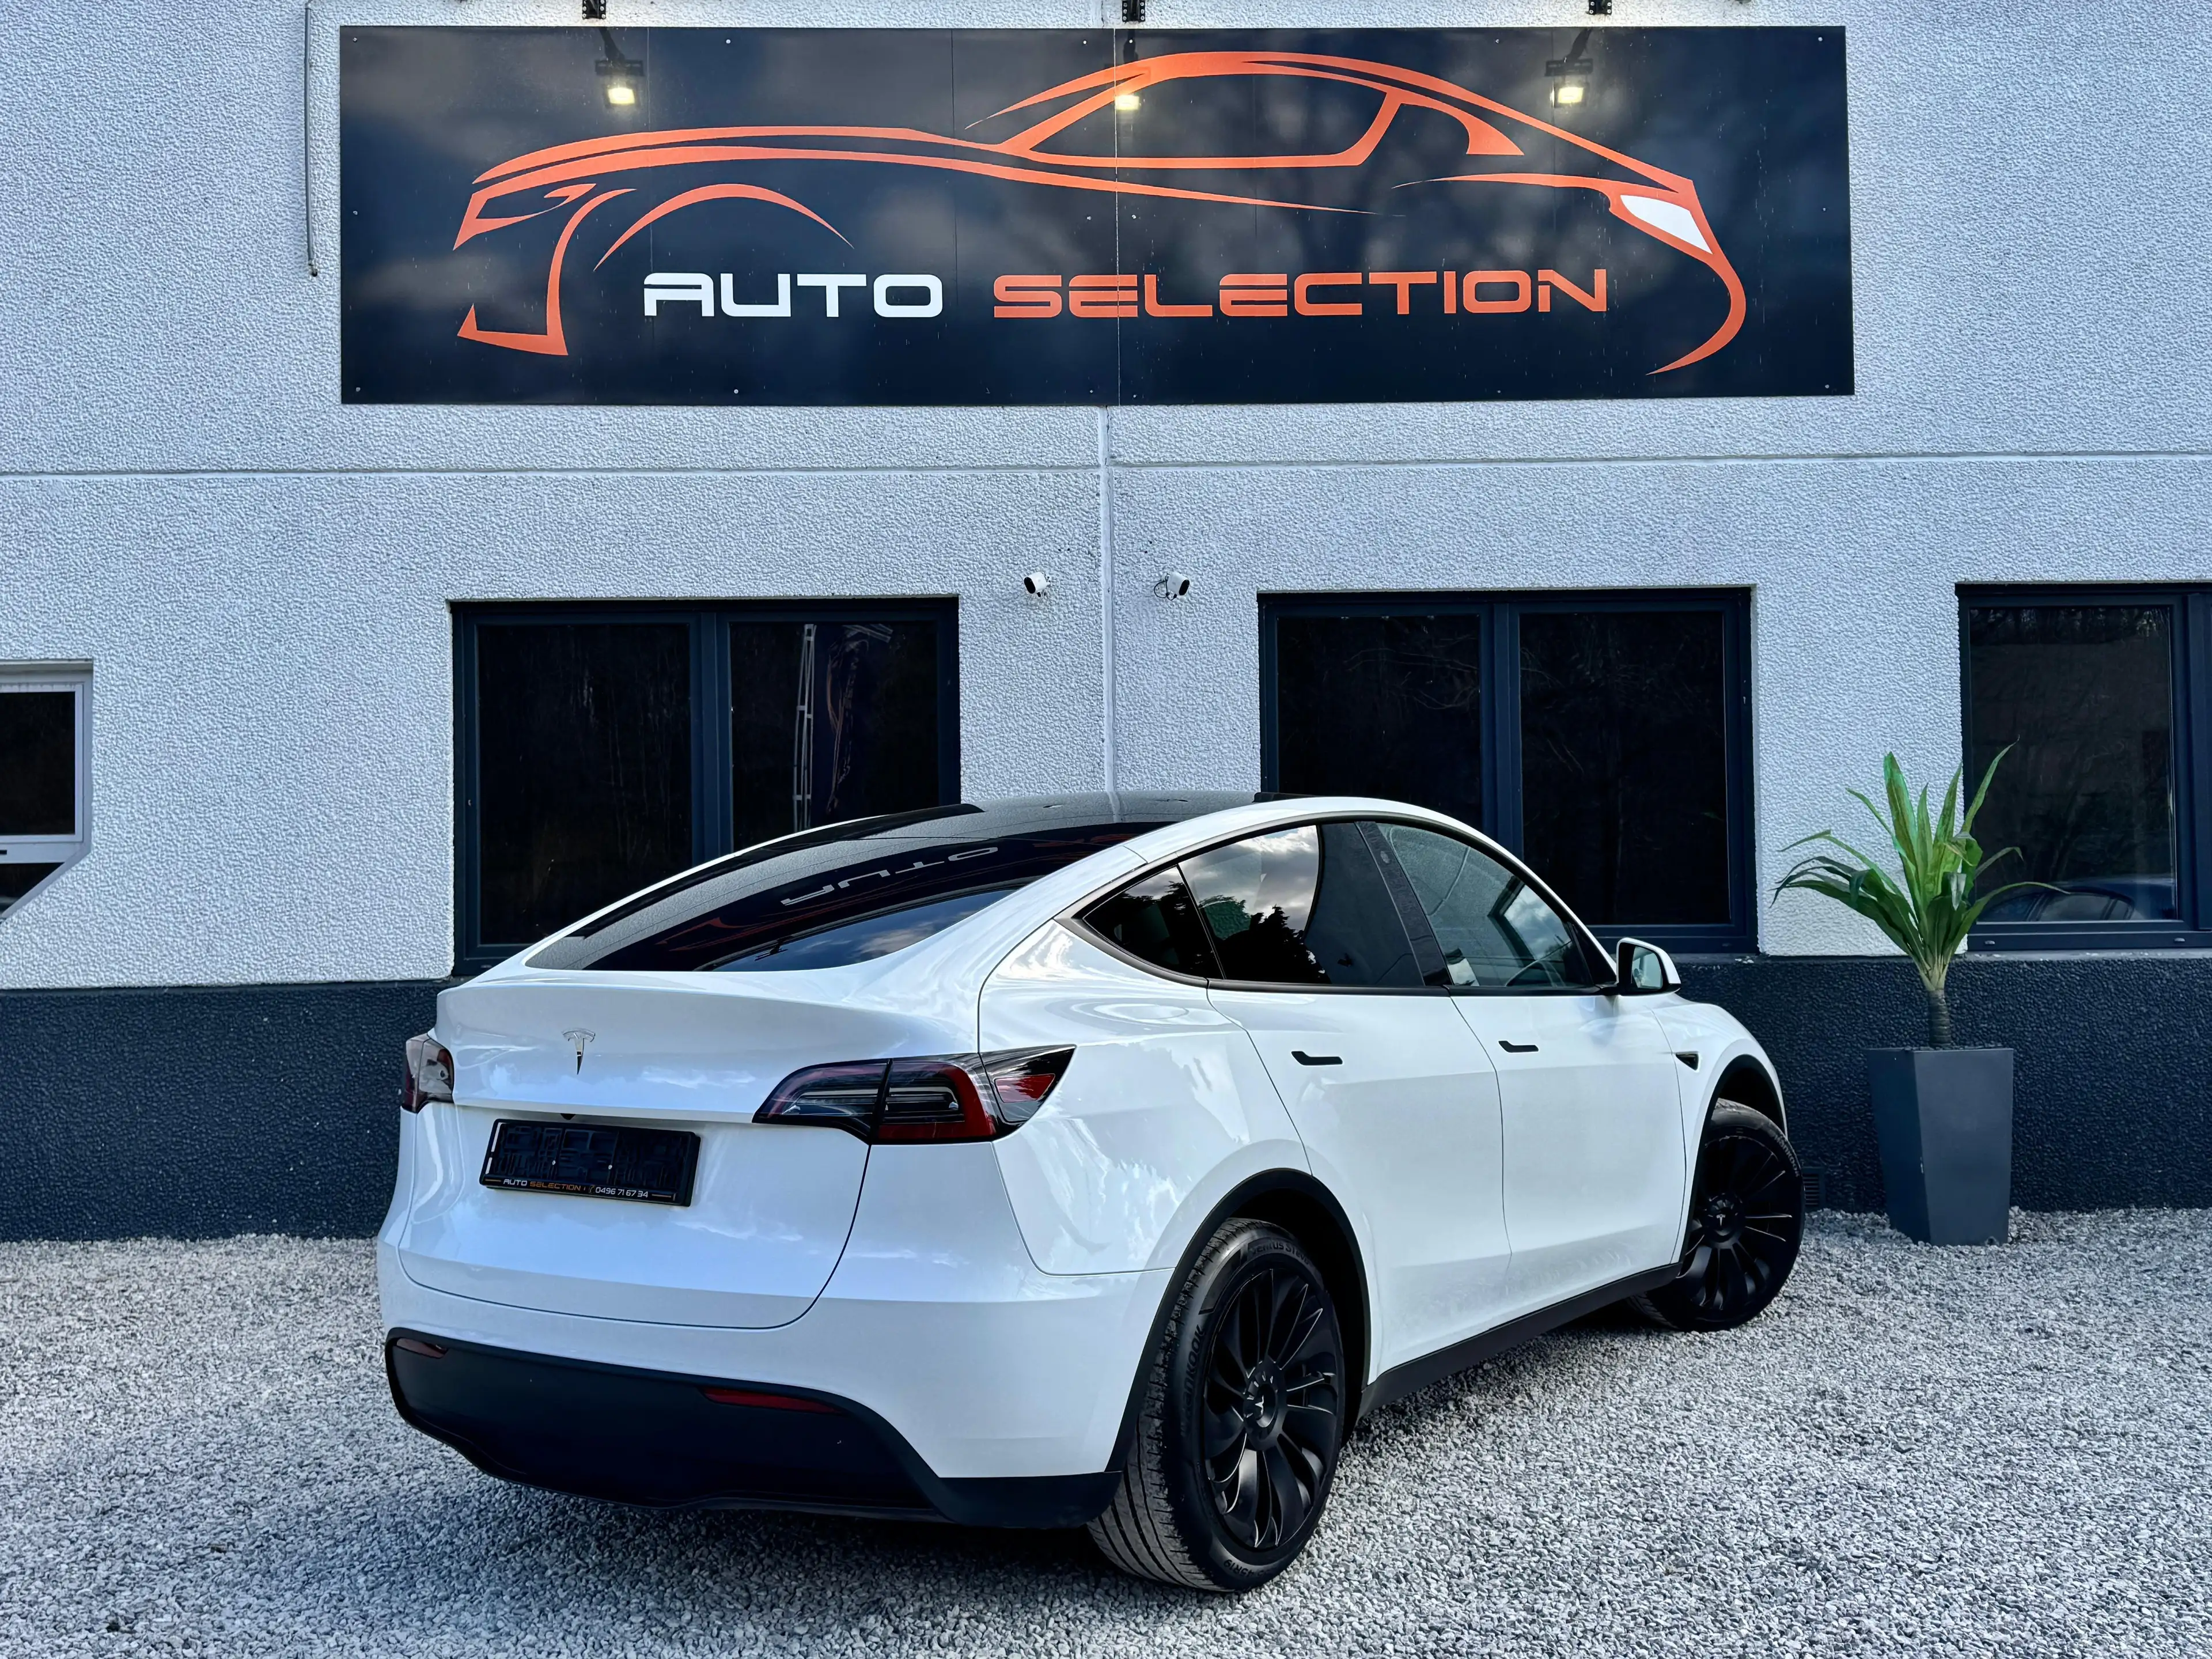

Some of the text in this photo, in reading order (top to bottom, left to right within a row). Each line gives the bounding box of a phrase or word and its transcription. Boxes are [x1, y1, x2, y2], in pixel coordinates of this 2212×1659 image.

[643, 268, 1607, 318] AUTO SELECTION
[530, 1181, 581, 1191] SELECTION
[595, 1187, 616, 1195] 0496
